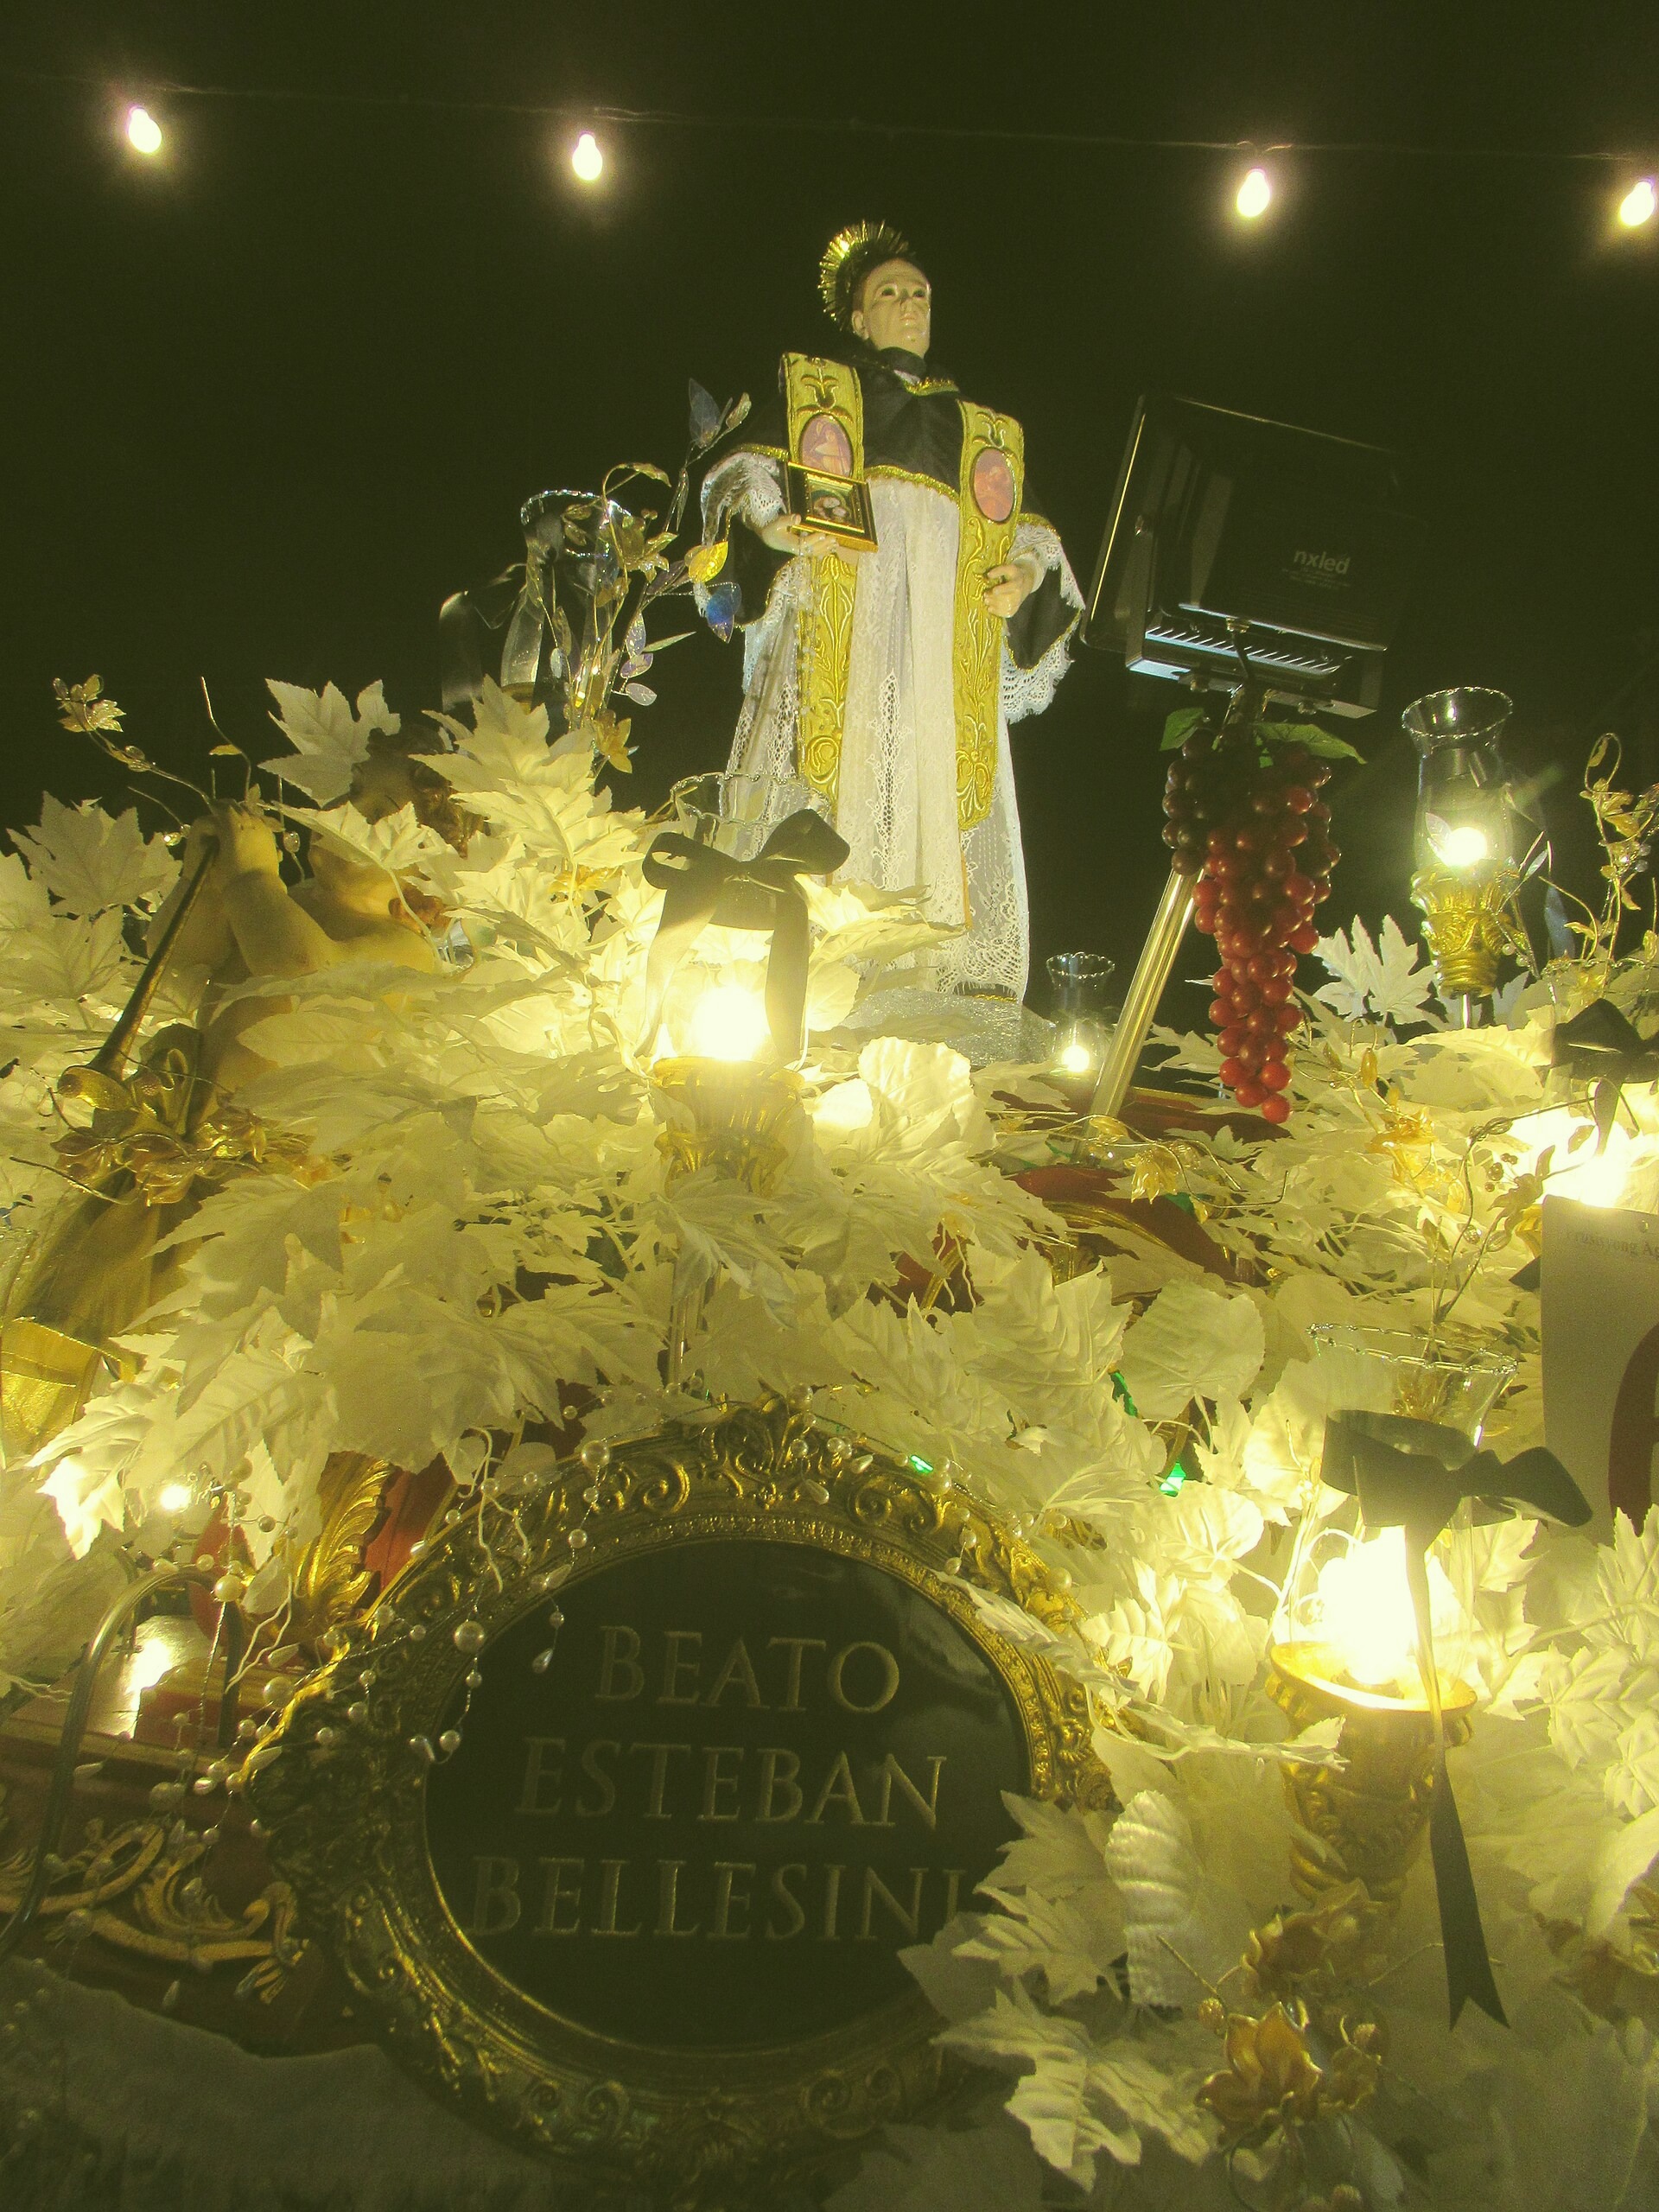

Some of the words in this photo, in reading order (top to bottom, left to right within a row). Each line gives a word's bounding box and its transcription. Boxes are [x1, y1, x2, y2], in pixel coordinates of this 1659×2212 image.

[1294, 550, 1351, 575] nxled
[594, 1624, 900, 1713] BEATO
[515, 1736, 948, 1830] ESTEBAN
